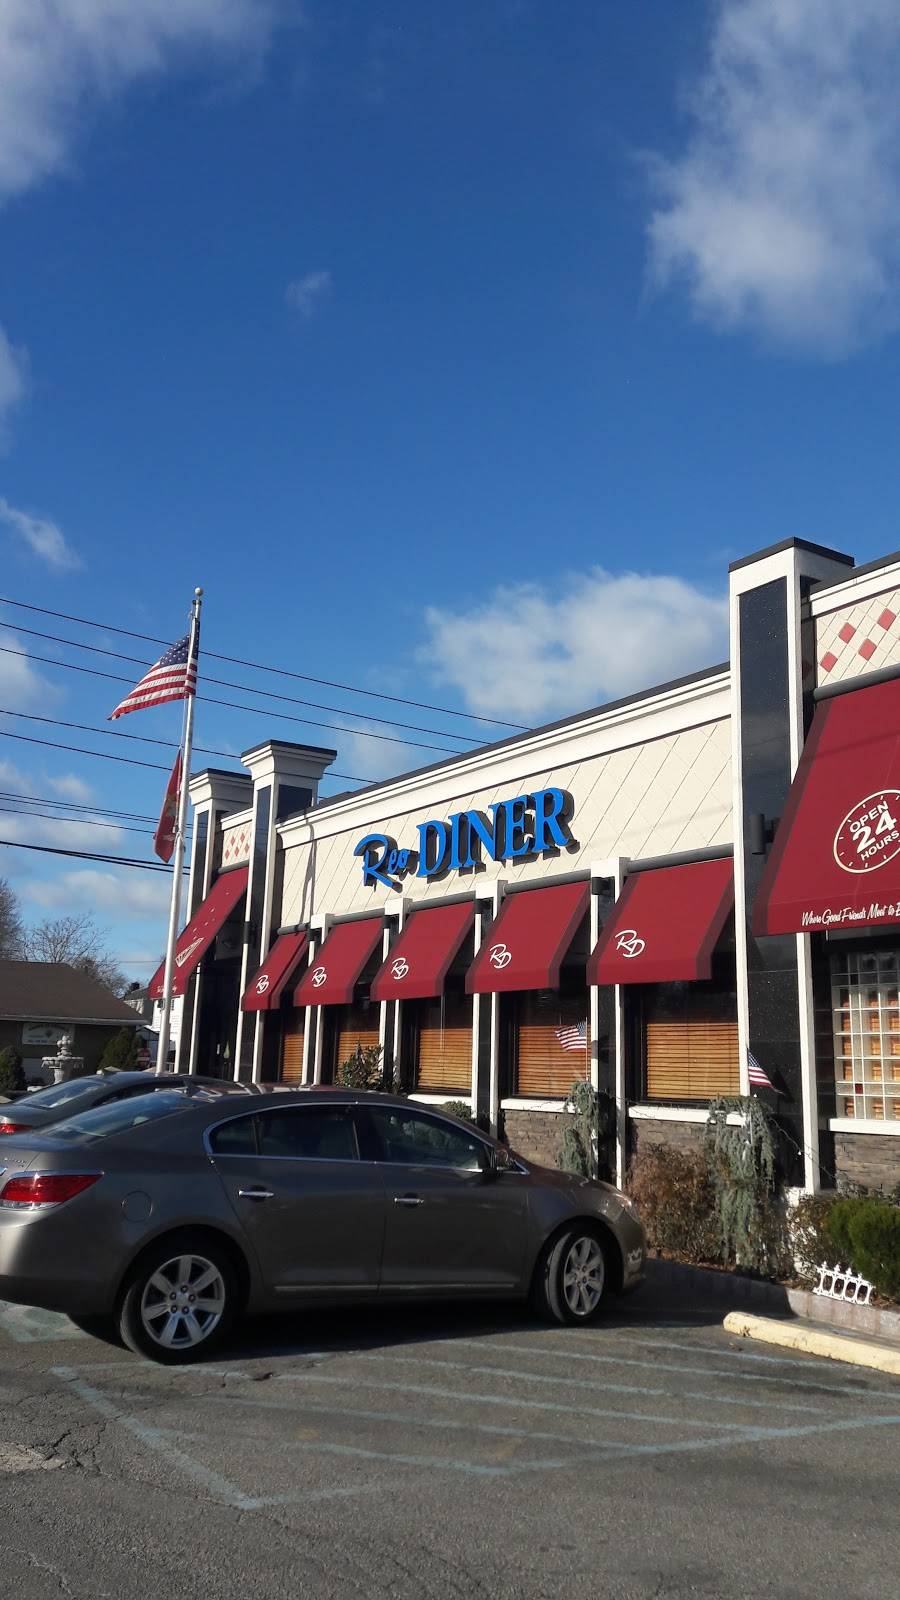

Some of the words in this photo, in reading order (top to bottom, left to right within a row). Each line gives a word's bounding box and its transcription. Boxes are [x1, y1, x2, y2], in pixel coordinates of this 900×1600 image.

[849, 801, 889, 833] OPEN
[852, 810, 898, 854] 24
[354, 833, 411, 889] Reo
[416, 787, 570, 877] DINER
[860, 830, 900, 861] HOURS
[801, 910, 822, 927] Where
[822, 908, 842, 925] Good
[842, 906, 866, 922] Friends
[867, 902, 887, 920] Meet
[887, 904, 895, 916] to
